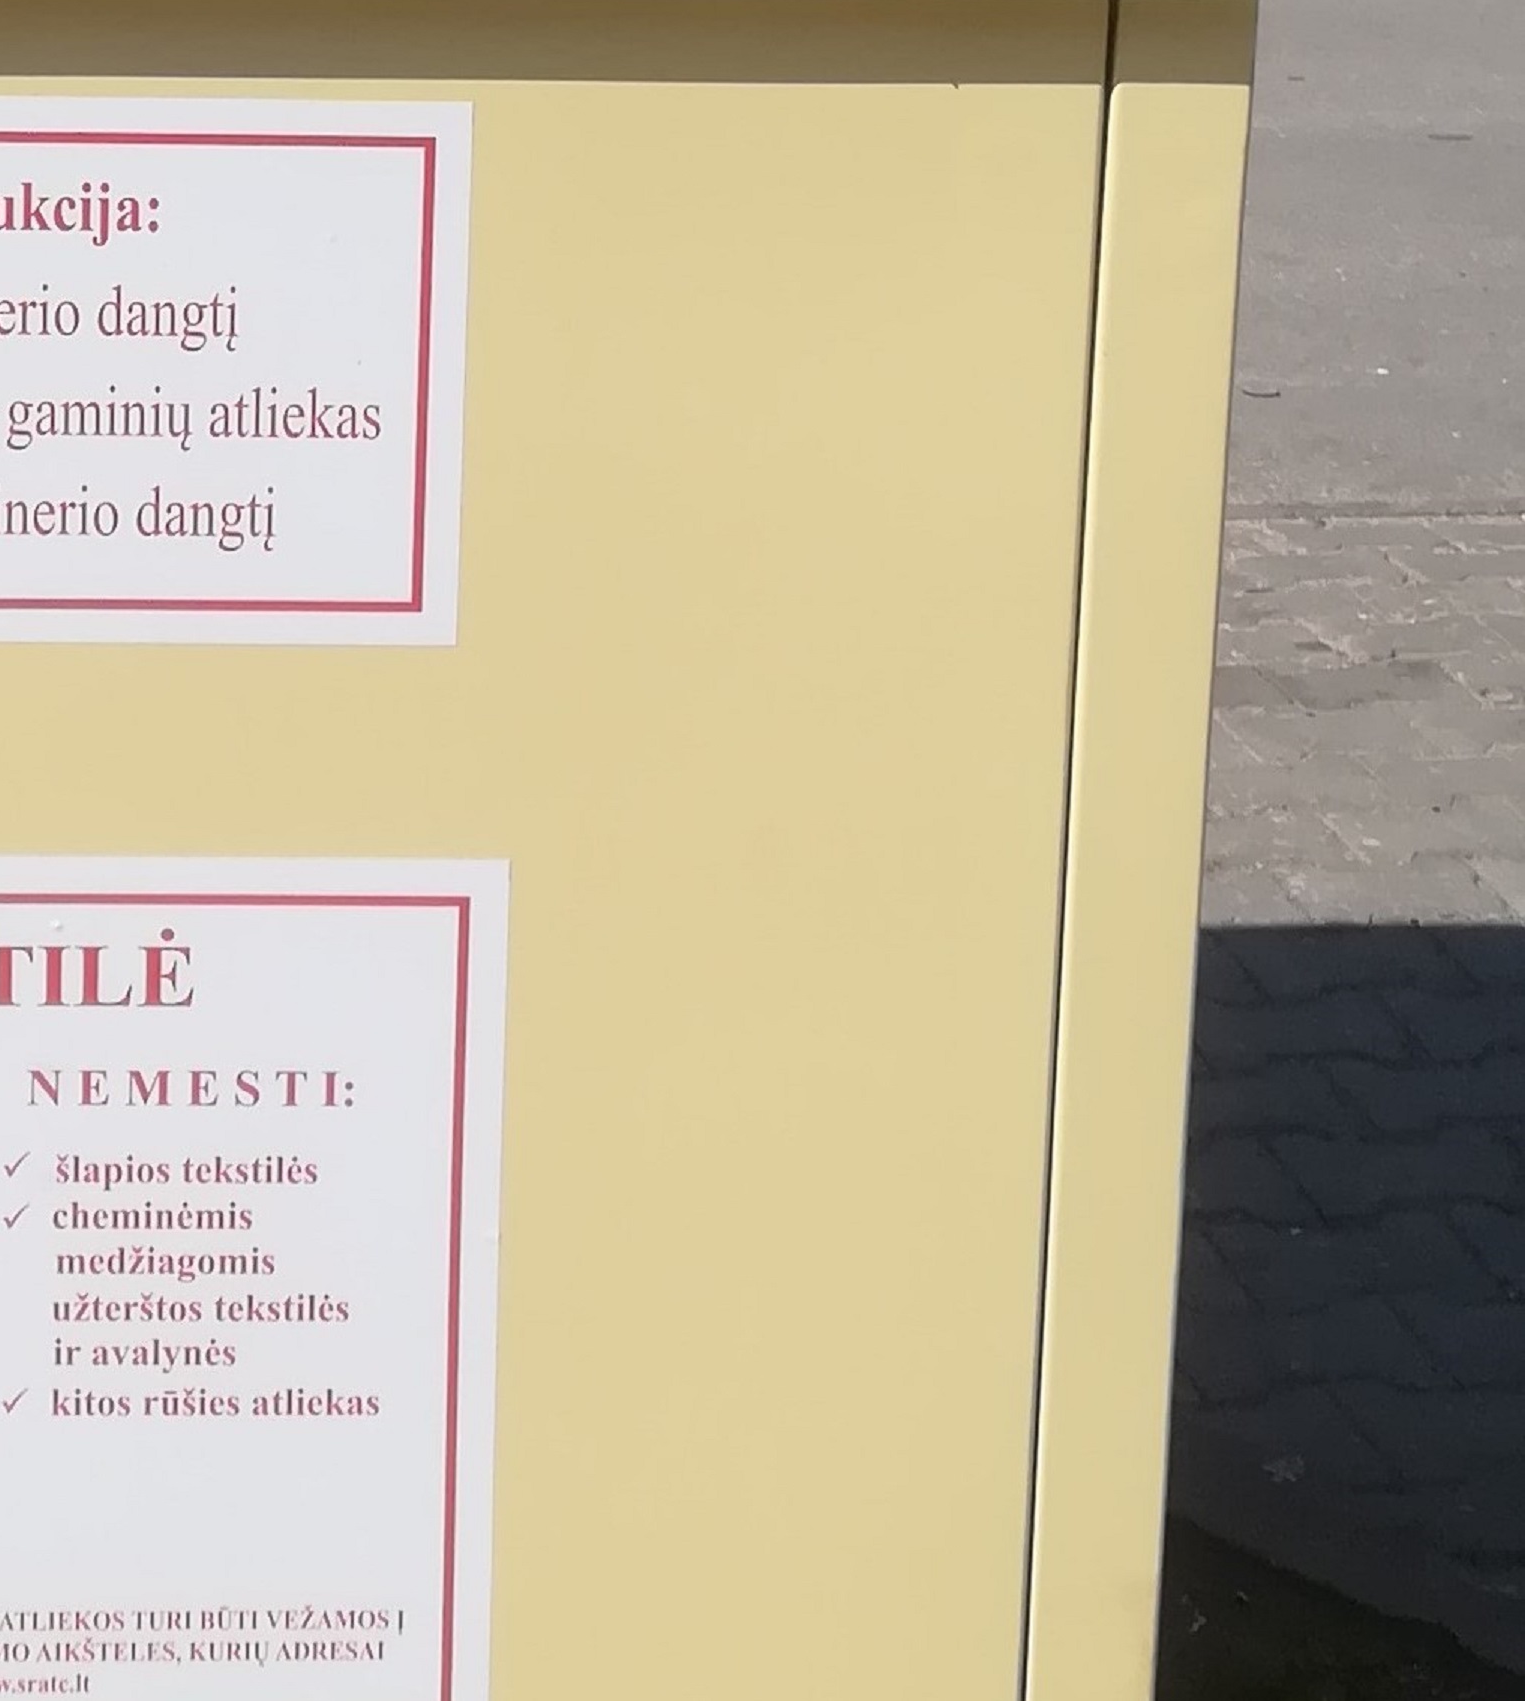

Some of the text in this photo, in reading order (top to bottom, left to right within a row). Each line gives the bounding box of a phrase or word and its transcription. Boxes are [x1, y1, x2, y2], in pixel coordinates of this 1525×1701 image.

[96, 283, 239, 353] dangtį
[6, 384, 193, 453] gaminių
[208, 386, 382, 441] atliekas
[135, 484, 277, 553] dangtį
[27, 1069, 355, 1108] NEMESTI:
[55, 1153, 319, 1192] šlapios tekstilės
[52, 1200, 253, 1231] cheminėmis
[56, 1244, 275, 1284] medžiagomis
[52, 1291, 350, 1323] užterštos tekstilės
[54, 1337, 236, 1375] ir avalynės
[51, 1387, 380, 1417] kitos rūšies atliekas
[131, 1610, 191, 1632] TURI
[200, 1605, 258, 1631] BŪTI
[266, 1605, 390, 1631] VEŽAMOS
[189, 1640, 269, 1668] KURIŲ
[275, 1640, 385, 1662] ADRESAI
